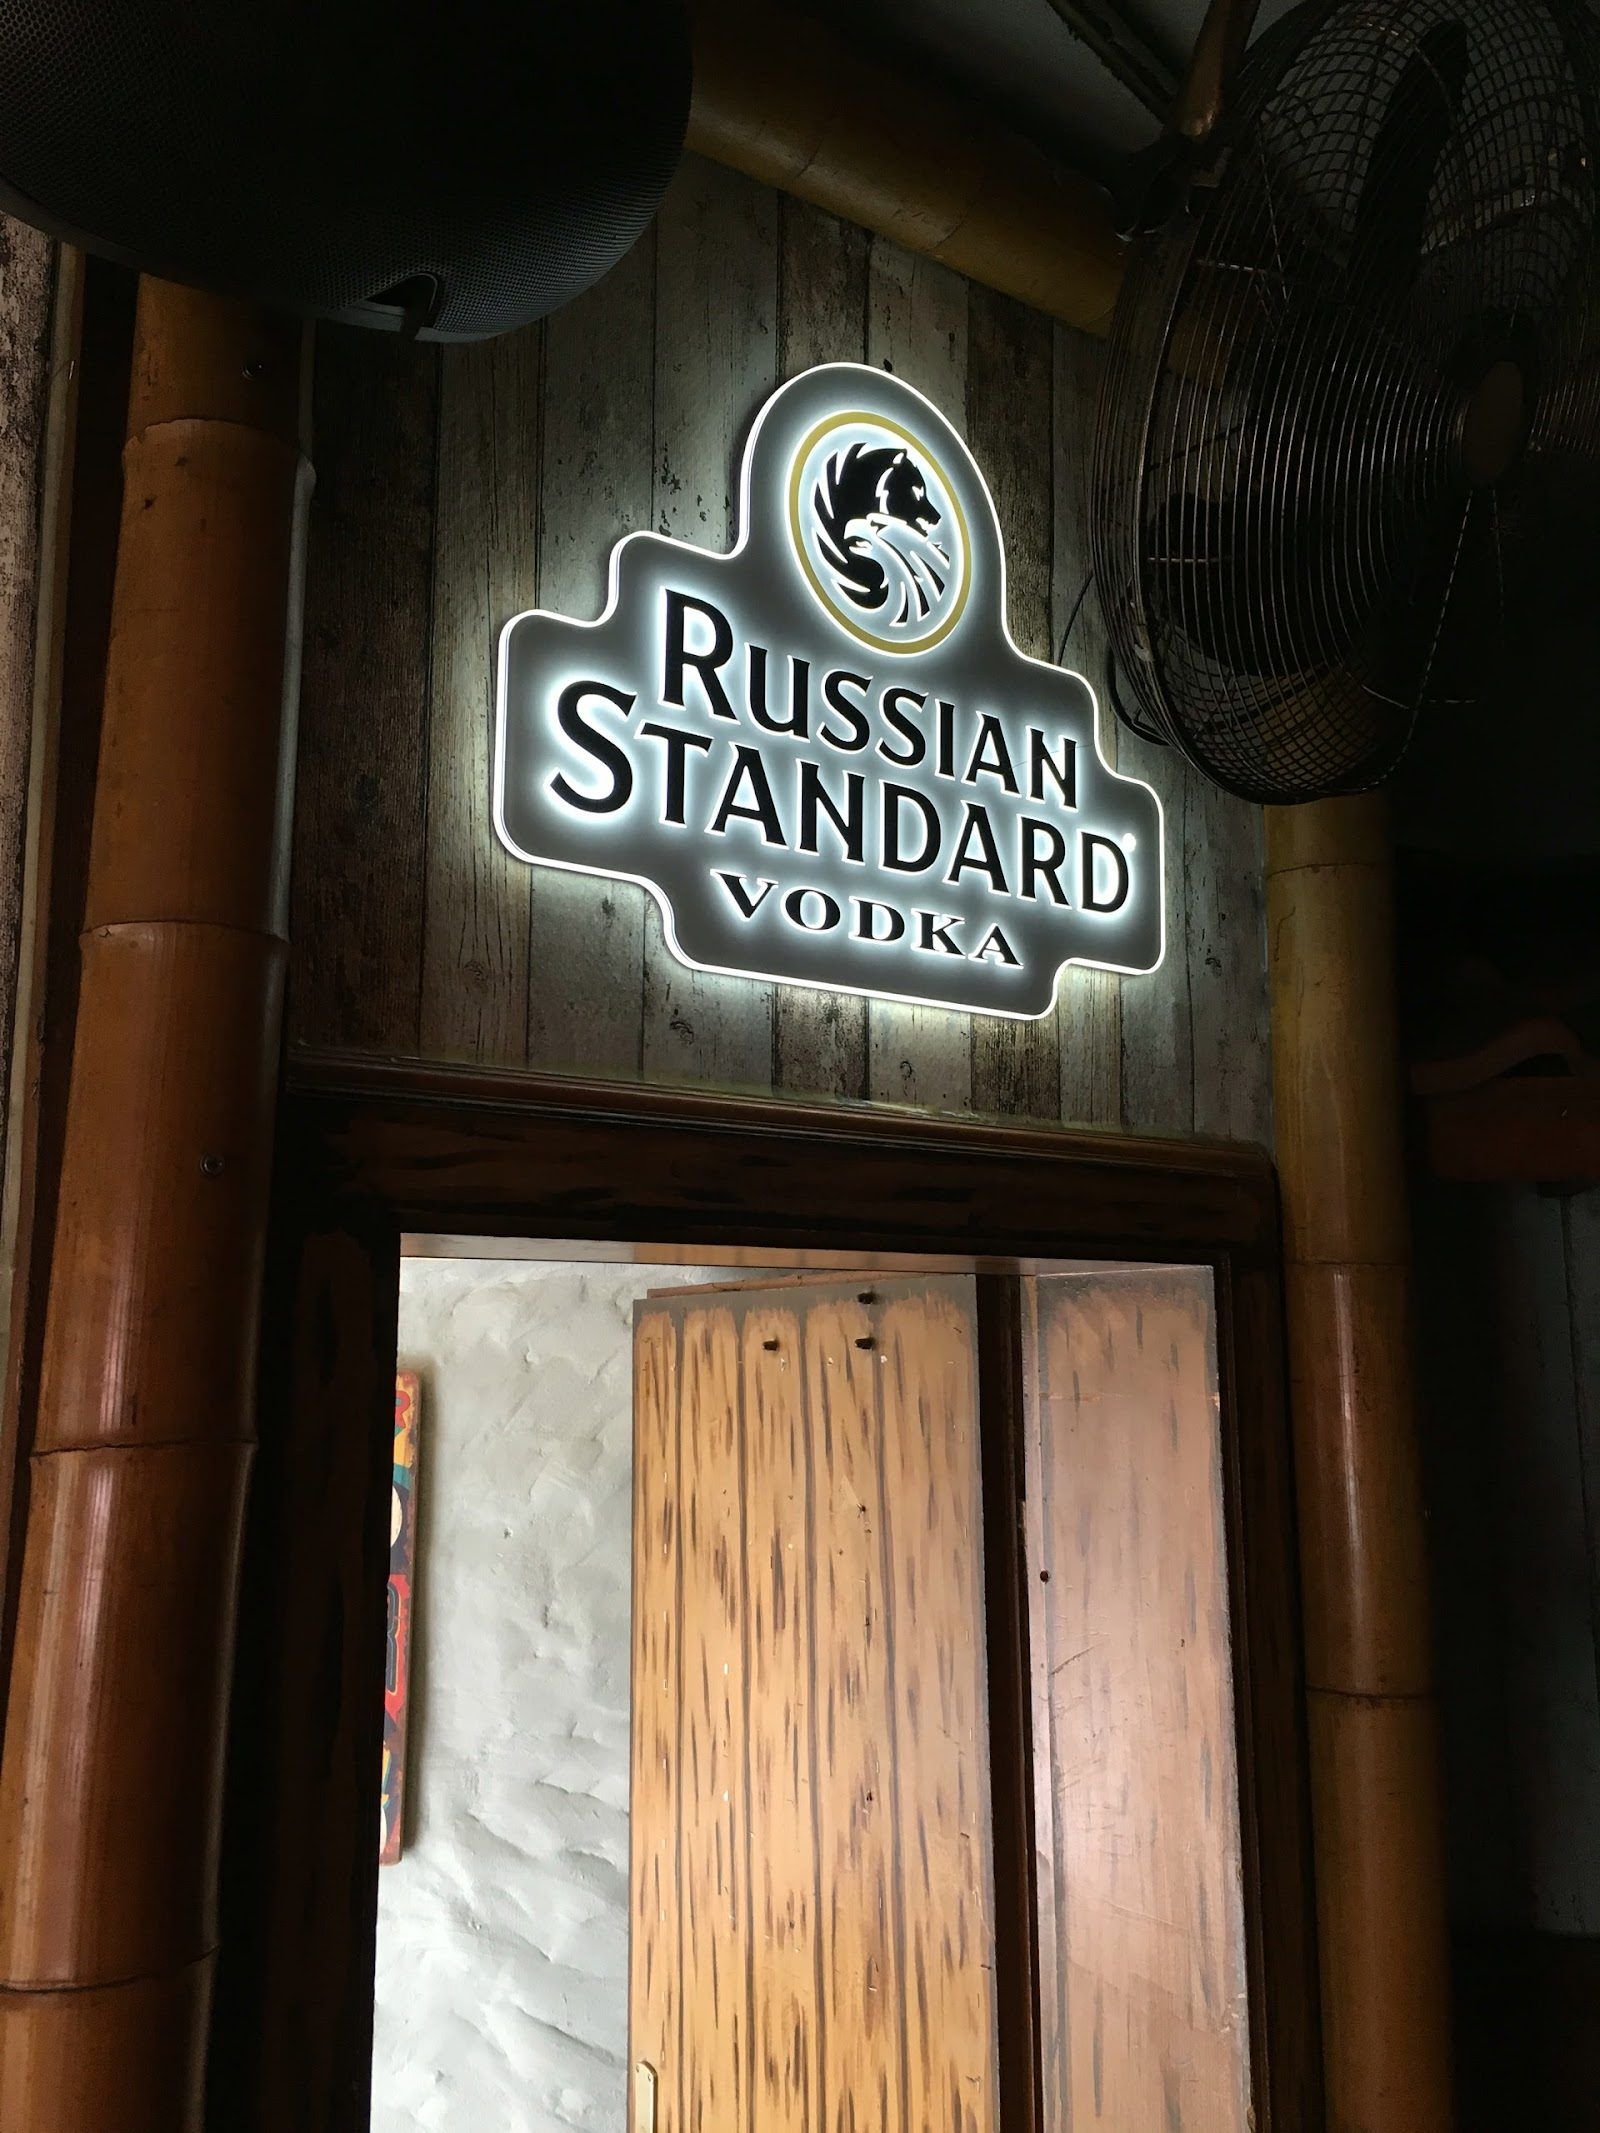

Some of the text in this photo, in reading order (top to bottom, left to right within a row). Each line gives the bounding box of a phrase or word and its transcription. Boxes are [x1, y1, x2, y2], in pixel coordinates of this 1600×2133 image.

[549, 681, 1130, 914] STANDARD
[663, 588, 1077, 809] RUSSIAN
[711, 872, 1024, 967] VODKA
